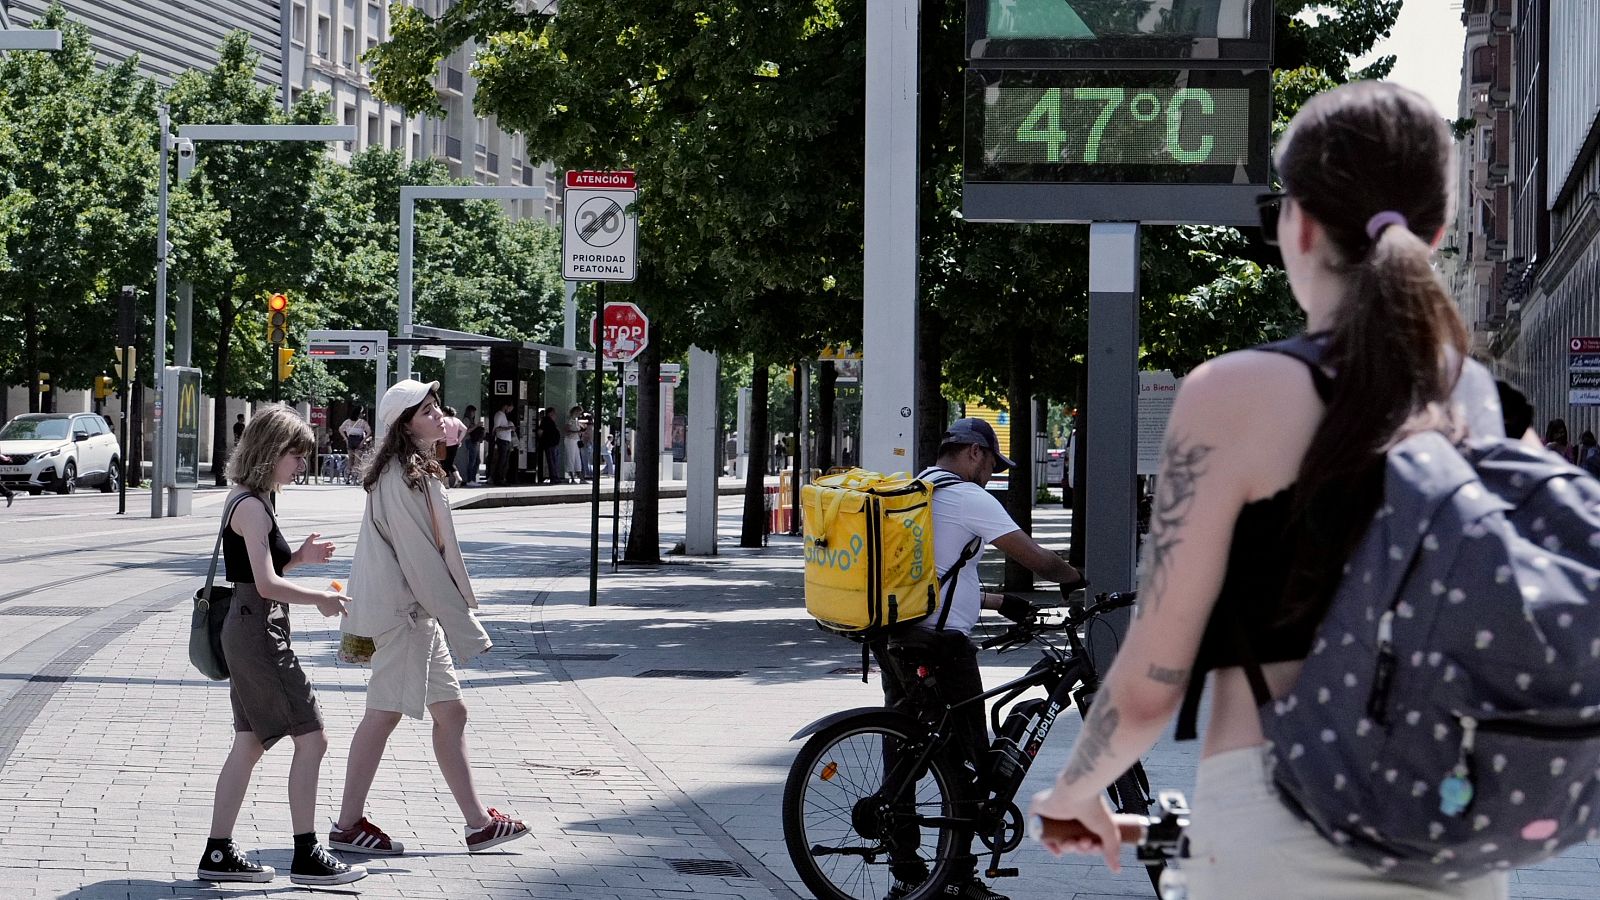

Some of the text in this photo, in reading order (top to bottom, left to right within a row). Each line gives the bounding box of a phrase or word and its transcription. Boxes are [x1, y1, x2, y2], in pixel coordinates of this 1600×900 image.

[1016, 87, 1214, 163] 47°C
[576, 174, 628, 184] ATENCIÓN
[581, 210, 620, 234] 20
[572, 254, 626, 263] PRIORIDAD
[573, 264, 625, 274] PEATONAL
[1141, 383, 1176, 392] La Bienal
[1033, 701, 1061, 743] TOPLIFE
